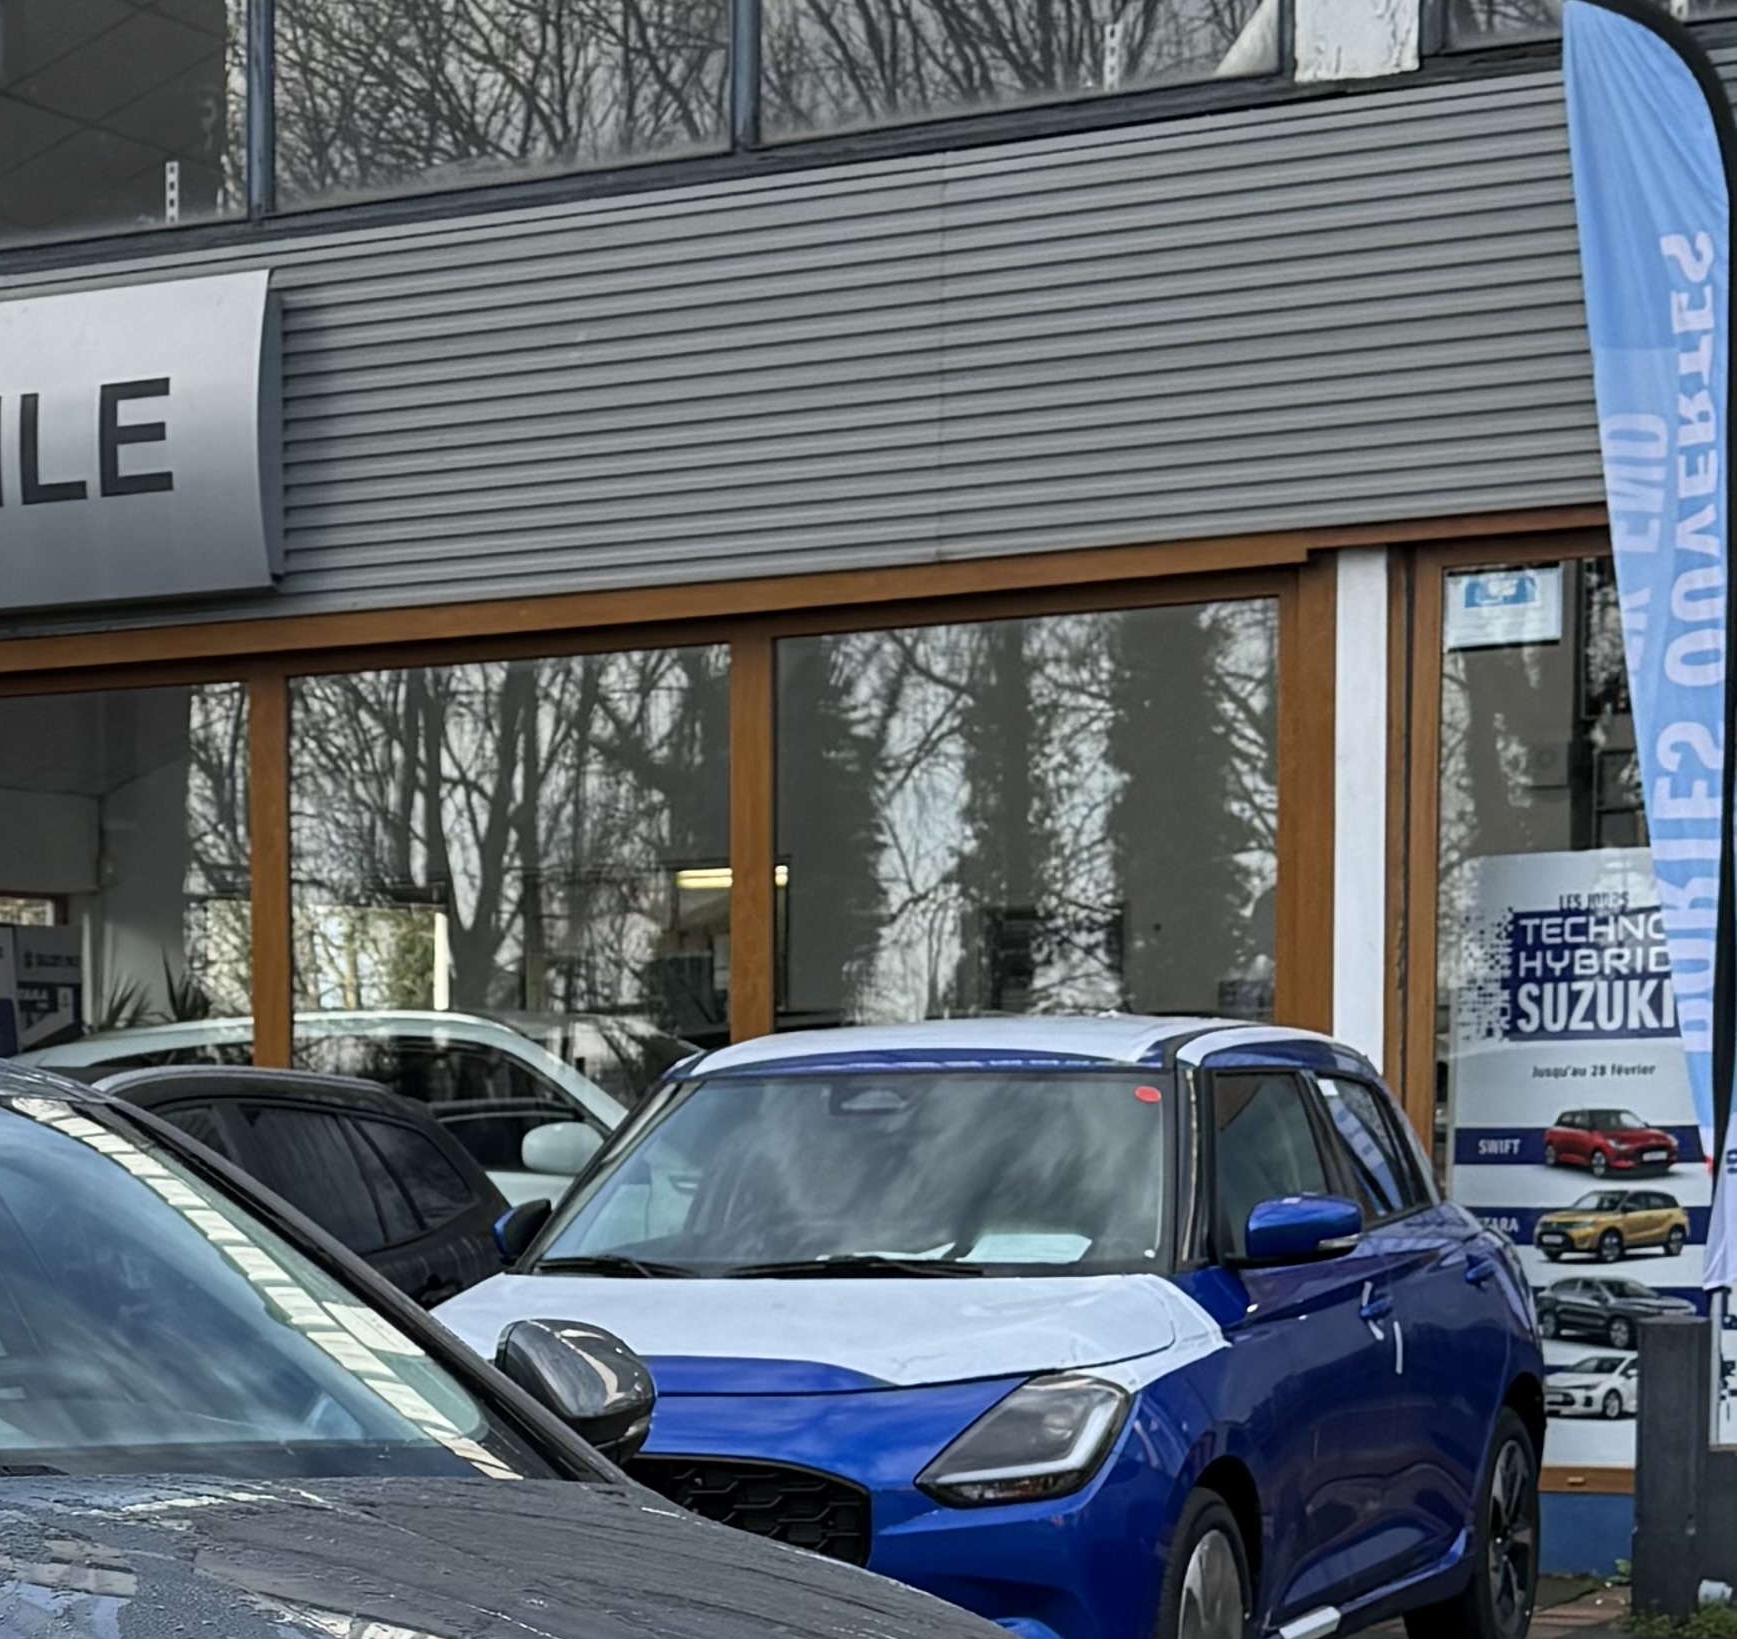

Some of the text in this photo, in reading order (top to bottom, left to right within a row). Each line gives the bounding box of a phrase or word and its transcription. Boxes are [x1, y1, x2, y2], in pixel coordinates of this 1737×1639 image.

[1517, 978, 1675, 1033] SUZUKI
[1532, 1063, 1656, 1079] Jusqu'au 28 février
[1478, 1138, 1521, 1155] SWIFT
